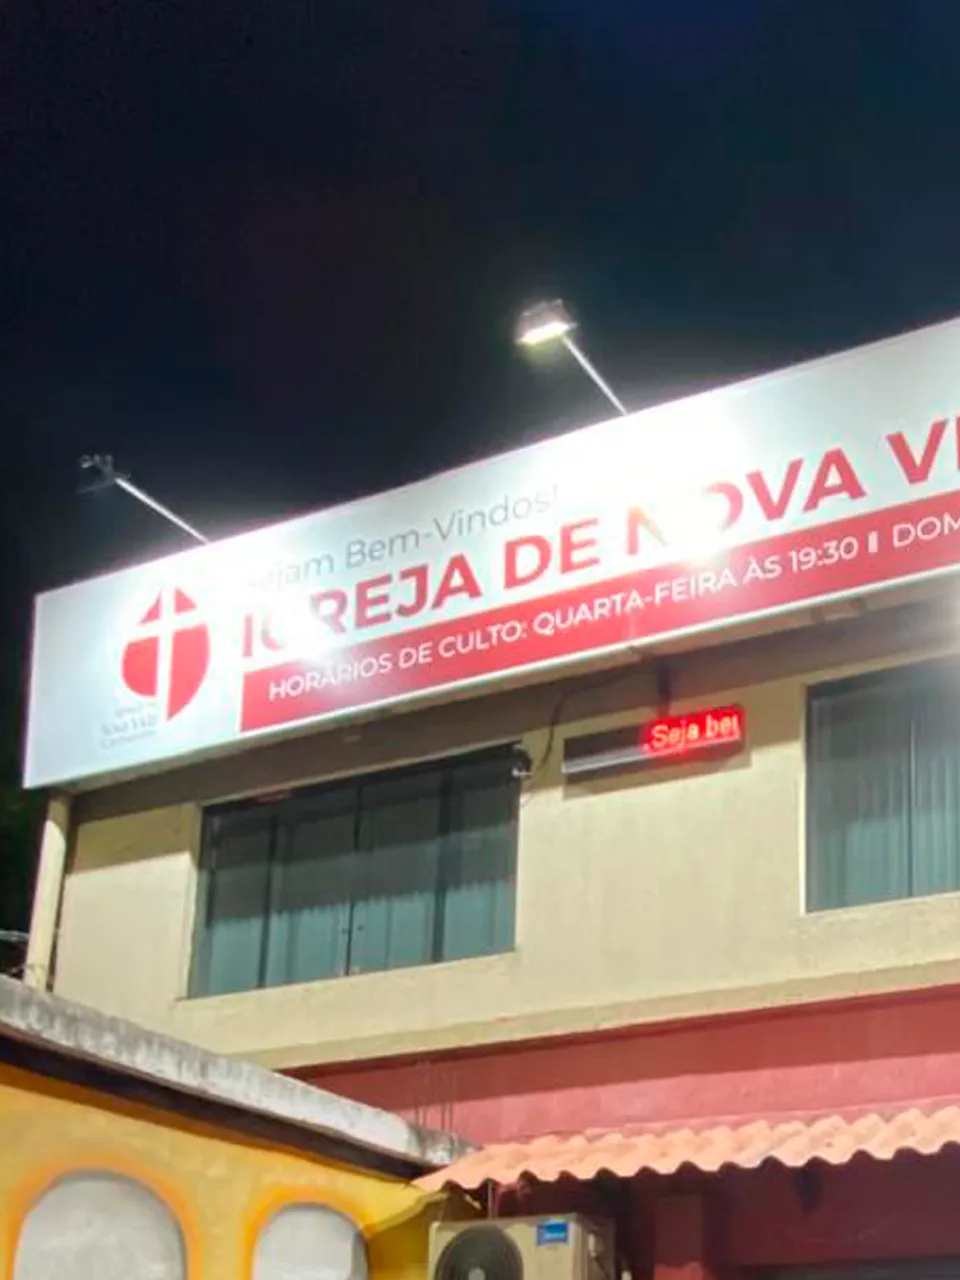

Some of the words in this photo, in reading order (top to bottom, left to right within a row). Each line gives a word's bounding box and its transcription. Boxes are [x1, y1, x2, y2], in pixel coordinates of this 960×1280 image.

[250, 552, 335, 592] jam
[344, 484, 559, 571] Bem-Vindos!
[503, 517, 601, 591] DE
[398, 641, 433, 669] DE
[438, 620, 528, 659] CULTO:
[532, 568, 738, 636] QUARTA-FEIRA
[742, 555, 783, 583] ÀS
[789, 536, 859, 573] 19:30
[652, 720, 700, 750] Seja
